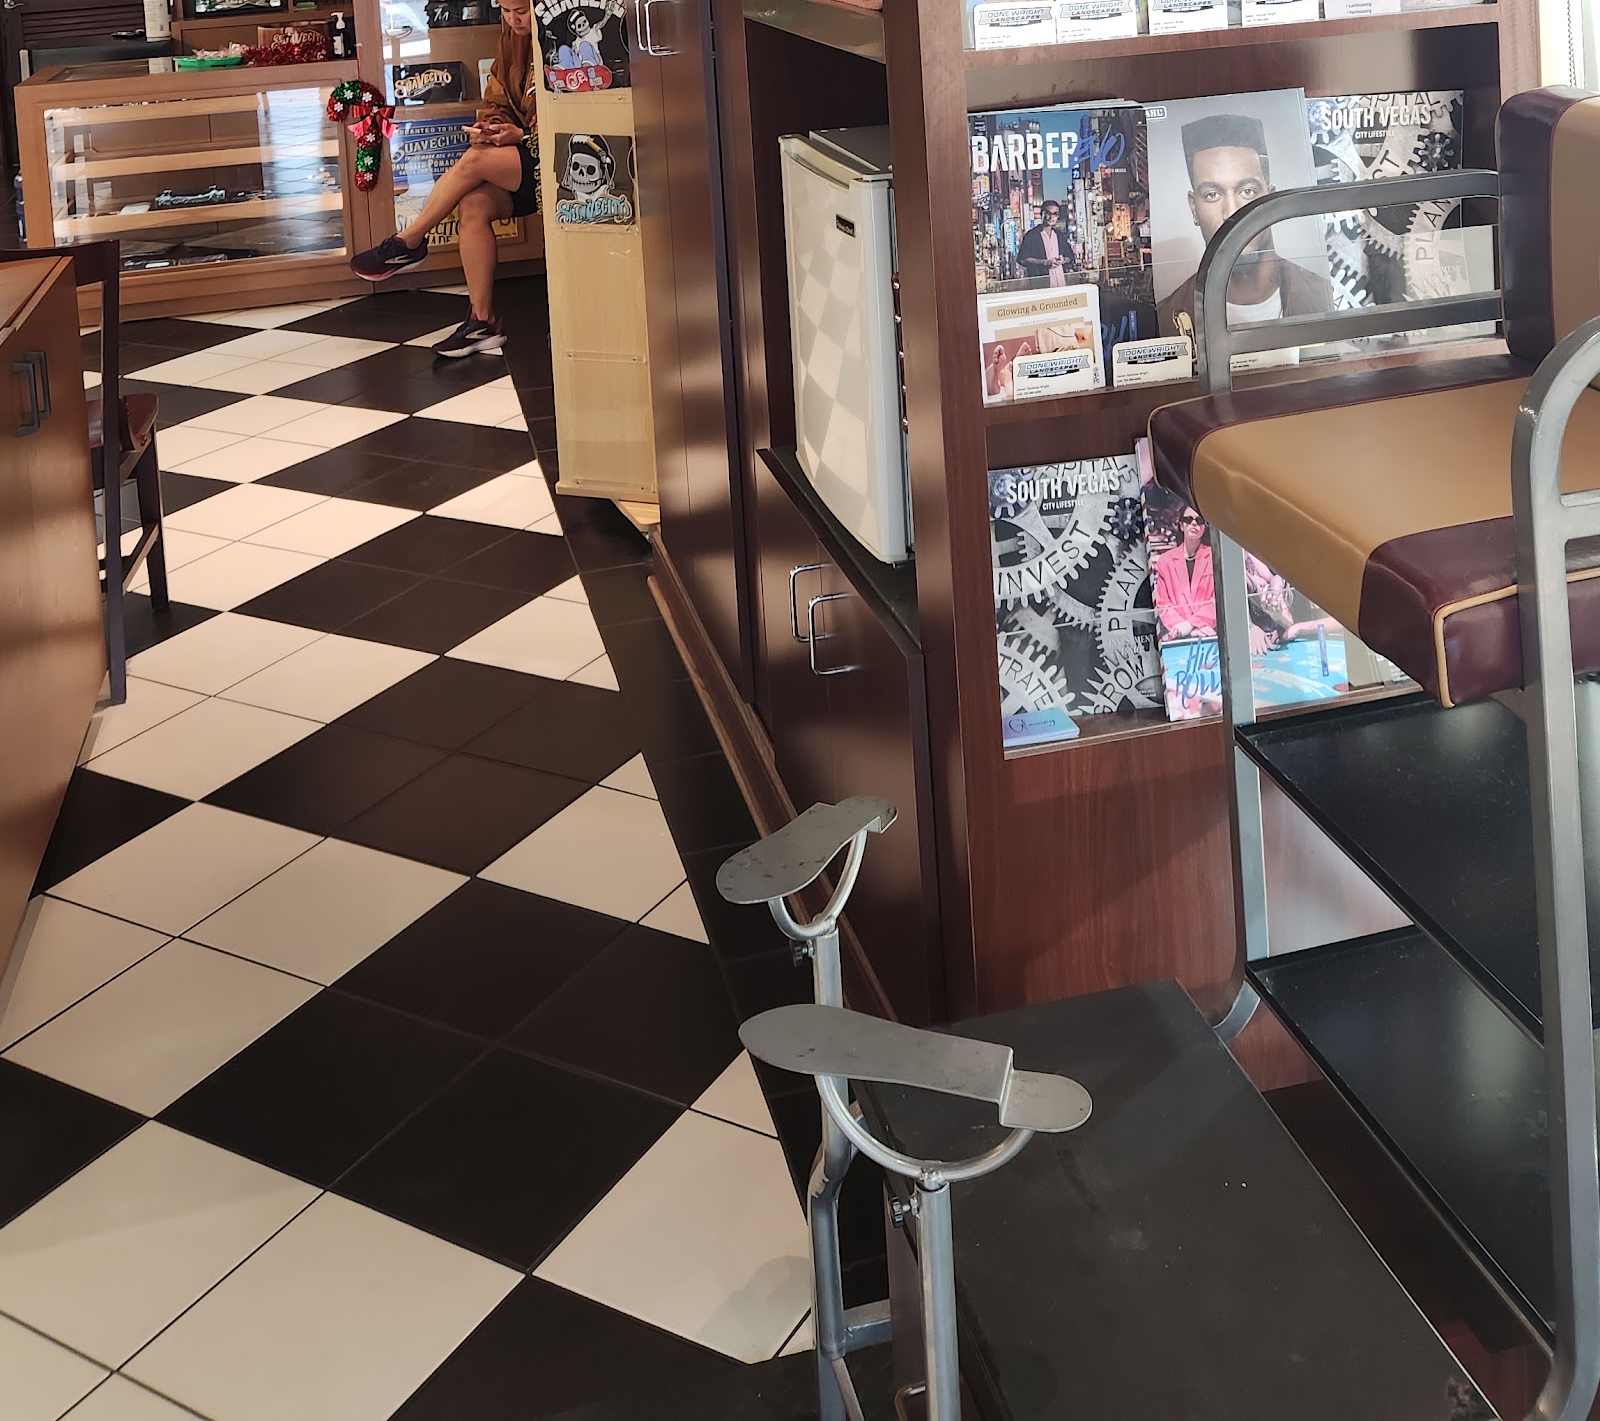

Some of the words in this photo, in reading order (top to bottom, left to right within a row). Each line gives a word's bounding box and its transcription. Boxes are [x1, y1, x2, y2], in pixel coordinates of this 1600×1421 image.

[394, 70, 452, 98] SUAVECITO
[1321, 107, 1374, 130] SOUTH
[1379, 105, 1431, 127] VEGAS
[1355, 130, 1367, 139] CITY
[1368, 129, 1395, 138] LIFESTYLE
[391, 133, 468, 163] SUAVECITO
[971, 131, 1079, 173] BARBER
[1063, 125, 1125, 173] EVO
[556, 197, 632, 224] SUAVECITO
[997, 306, 1030, 317] Glowing
[1040, 298, 1078, 310] Grounded
[1129, 351, 1176, 360] LANDSCAPES
[1149, 345, 1180, 353] WRIGHT
[1030, 365, 1078, 373] LANDSCAPES
[1051, 358, 1082, 367] WRIGHT
[1006, 477, 1062, 503] SOUTH
[1067, 471, 1120, 496] VEGAS
[1042, 501, 1056, 511] CITY
[1056, 499, 1085, 509] LIFESTYLE
[998, 520, 1090, 595] INVEST
[1108, 559, 1145, 632] PLAN
